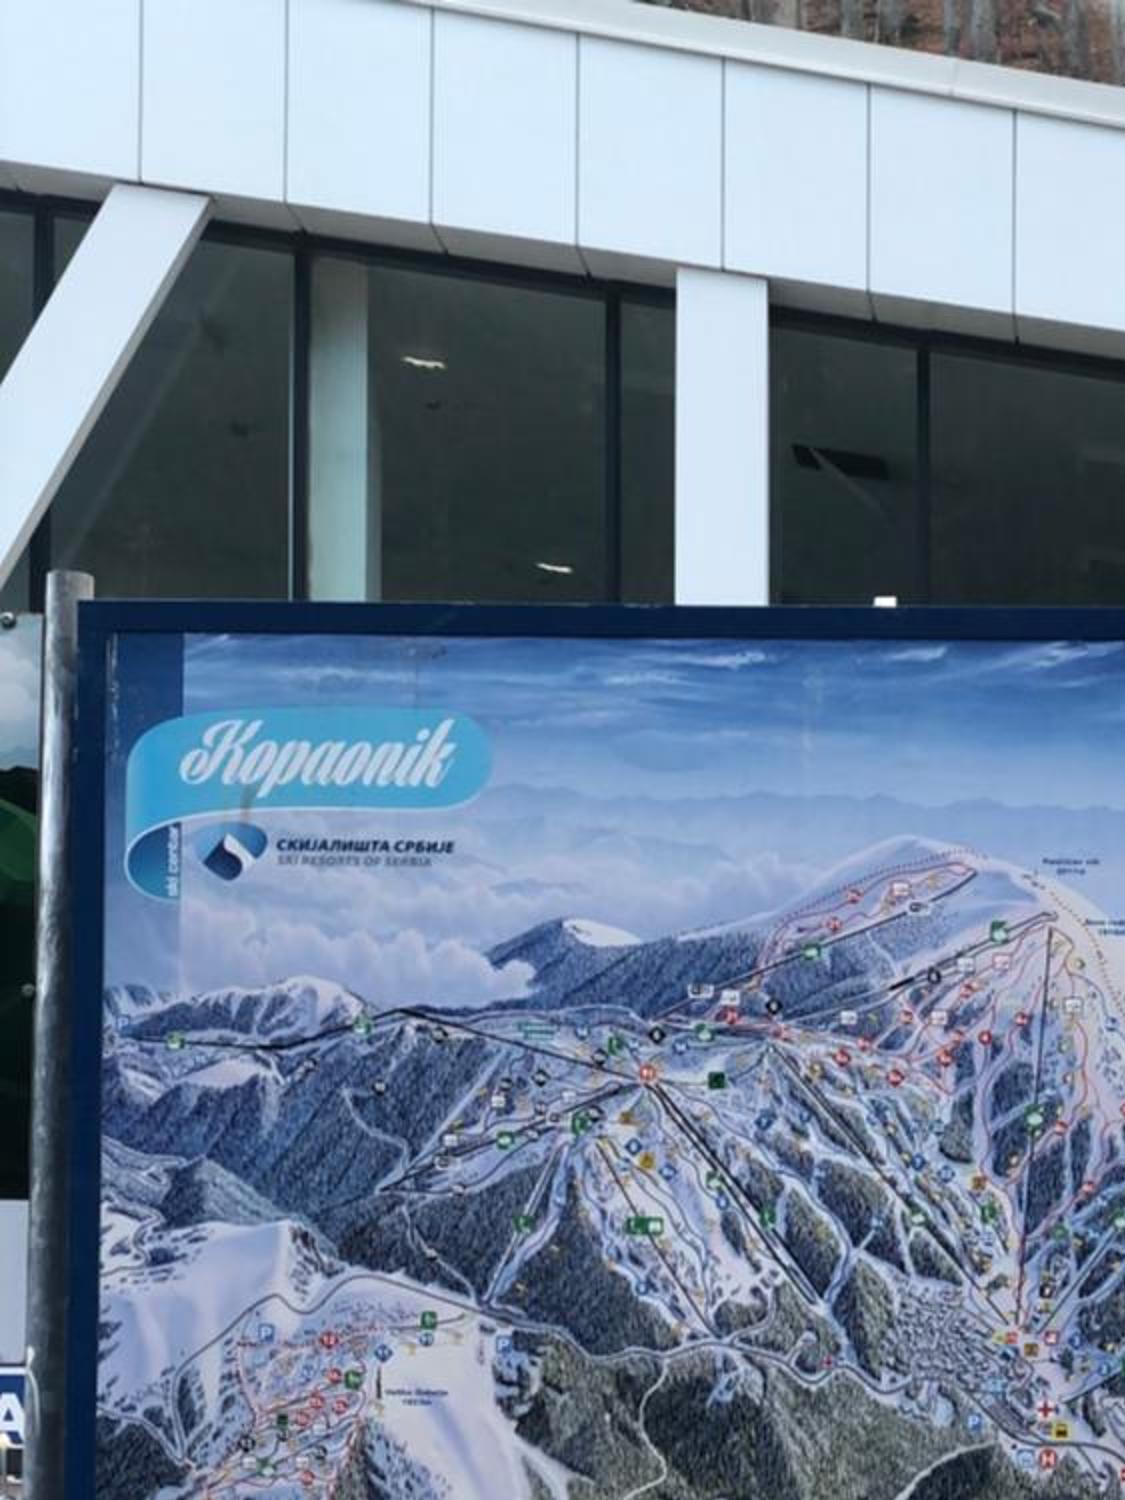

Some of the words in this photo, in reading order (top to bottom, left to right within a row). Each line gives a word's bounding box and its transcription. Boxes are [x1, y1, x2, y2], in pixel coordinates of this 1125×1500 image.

[179, 719, 456, 798] Kopaonik
[276, 837, 390, 852] СКИЈАЛИШТА
[394, 840, 455, 854] СРБИЈЕ
[278, 855, 295, 866] SKI
[300, 855, 361, 867] RESORTS
[364, 856, 381, 867] OF
[386, 856, 433, 867] SERBIA
